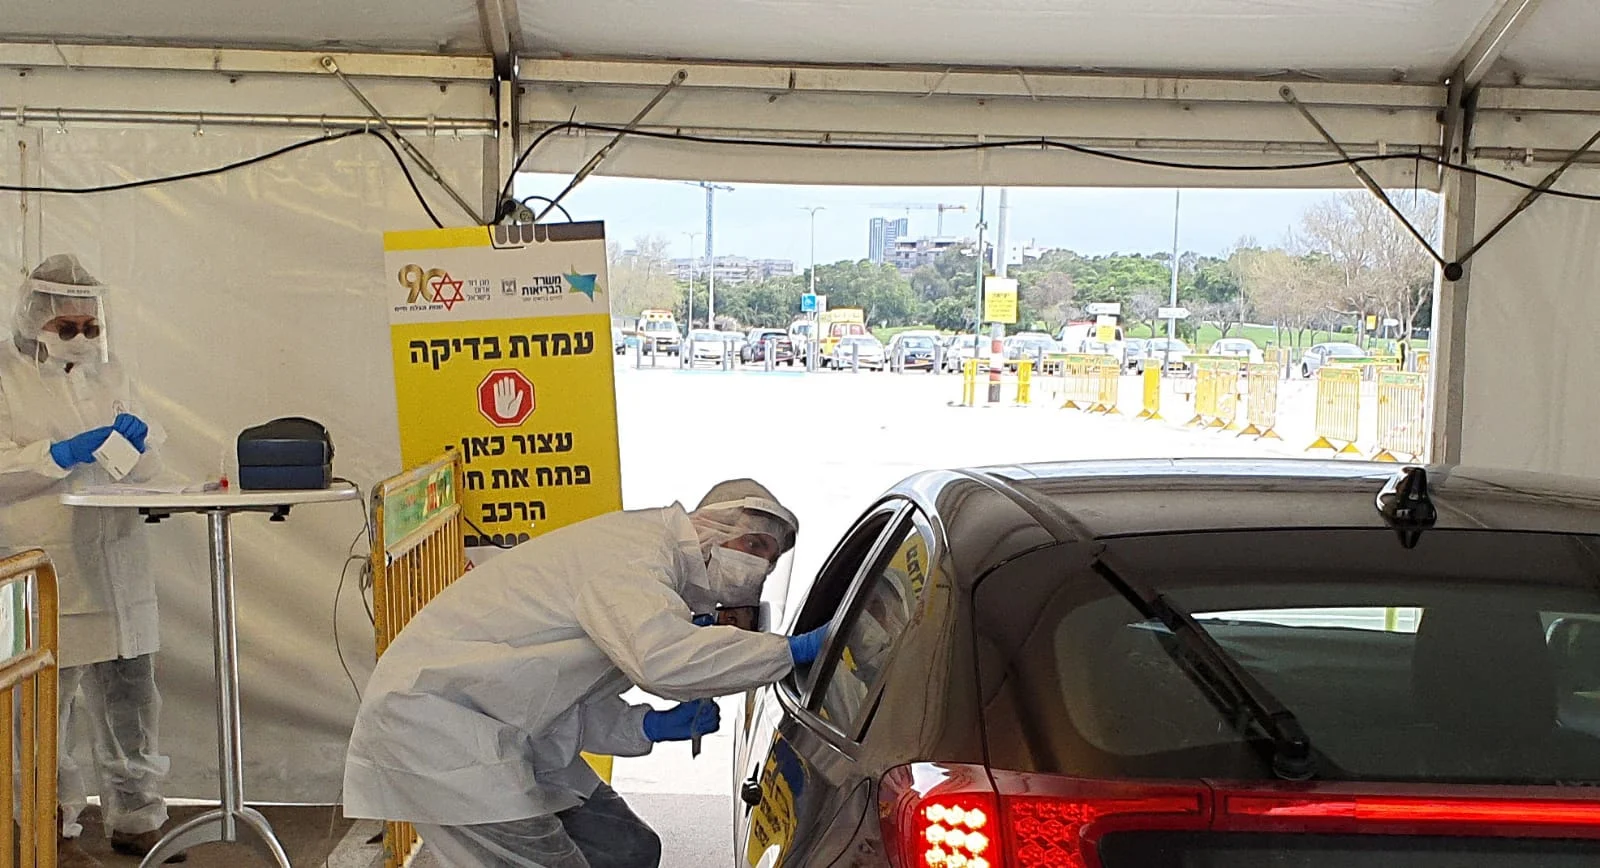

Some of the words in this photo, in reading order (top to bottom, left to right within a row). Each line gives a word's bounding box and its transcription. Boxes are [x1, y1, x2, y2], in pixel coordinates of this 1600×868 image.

[521, 284, 562, 296] הבריאות
[533, 275, 561, 286] משרד
[409, 335, 502, 370] בדיקה
[509, 331, 594, 359] עמדת
[461, 435, 505, 464] כאן
[511, 431, 573, 454] עצור
[491, 467, 530, 489] את
[535, 464, 591, 486] פתח
[482, 500, 546, 523] הרכב
